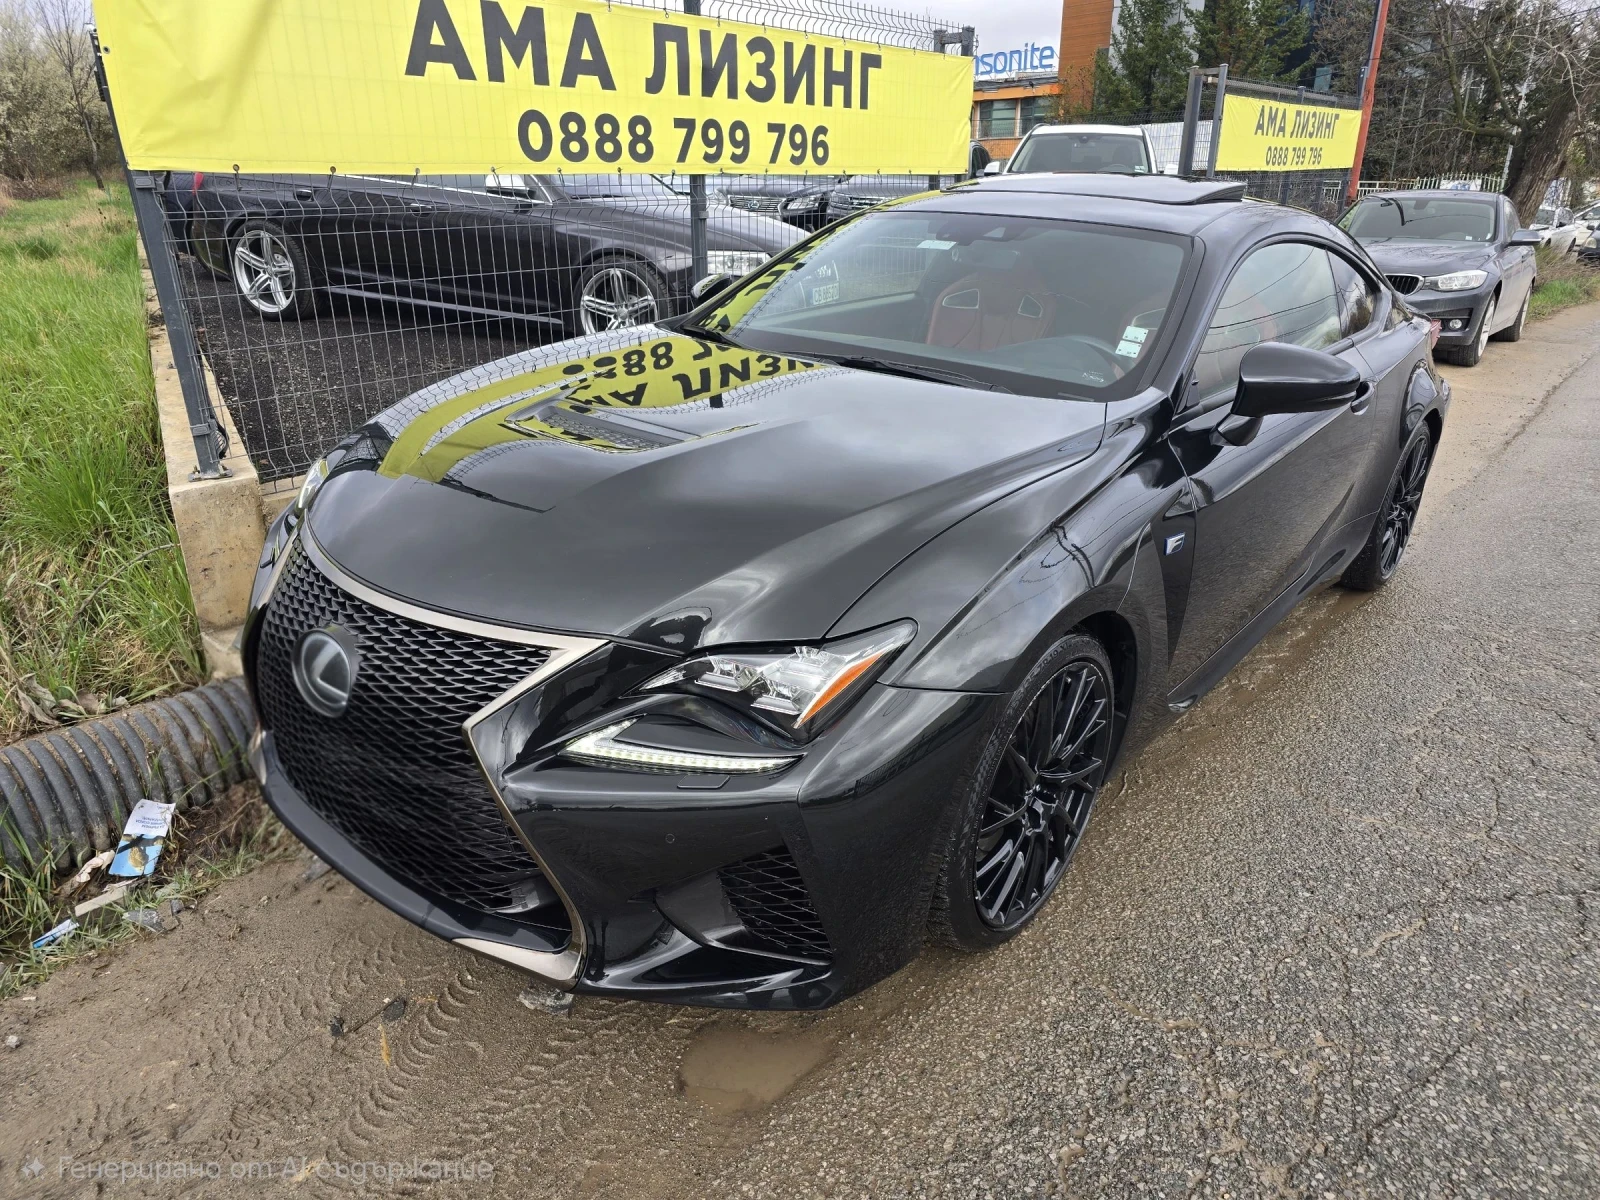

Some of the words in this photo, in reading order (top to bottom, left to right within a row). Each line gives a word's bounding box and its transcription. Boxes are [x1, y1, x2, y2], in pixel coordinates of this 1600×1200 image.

[404, 0, 618, 91] АМА
[645, 22, 882, 110] ЛИЗИНГ
[518, 109, 654, 163] 0888
[673, 117, 750, 165] 799
[767, 122, 829, 166] 796
[1254, 104, 1287, 138] АМА
[1289, 109, 1340, 139] ЛИЗИНГ
[1265, 145, 1289, 166] 0888
[1290, 146, 1307, 166] 799
[1307, 146, 1323, 166] 796
